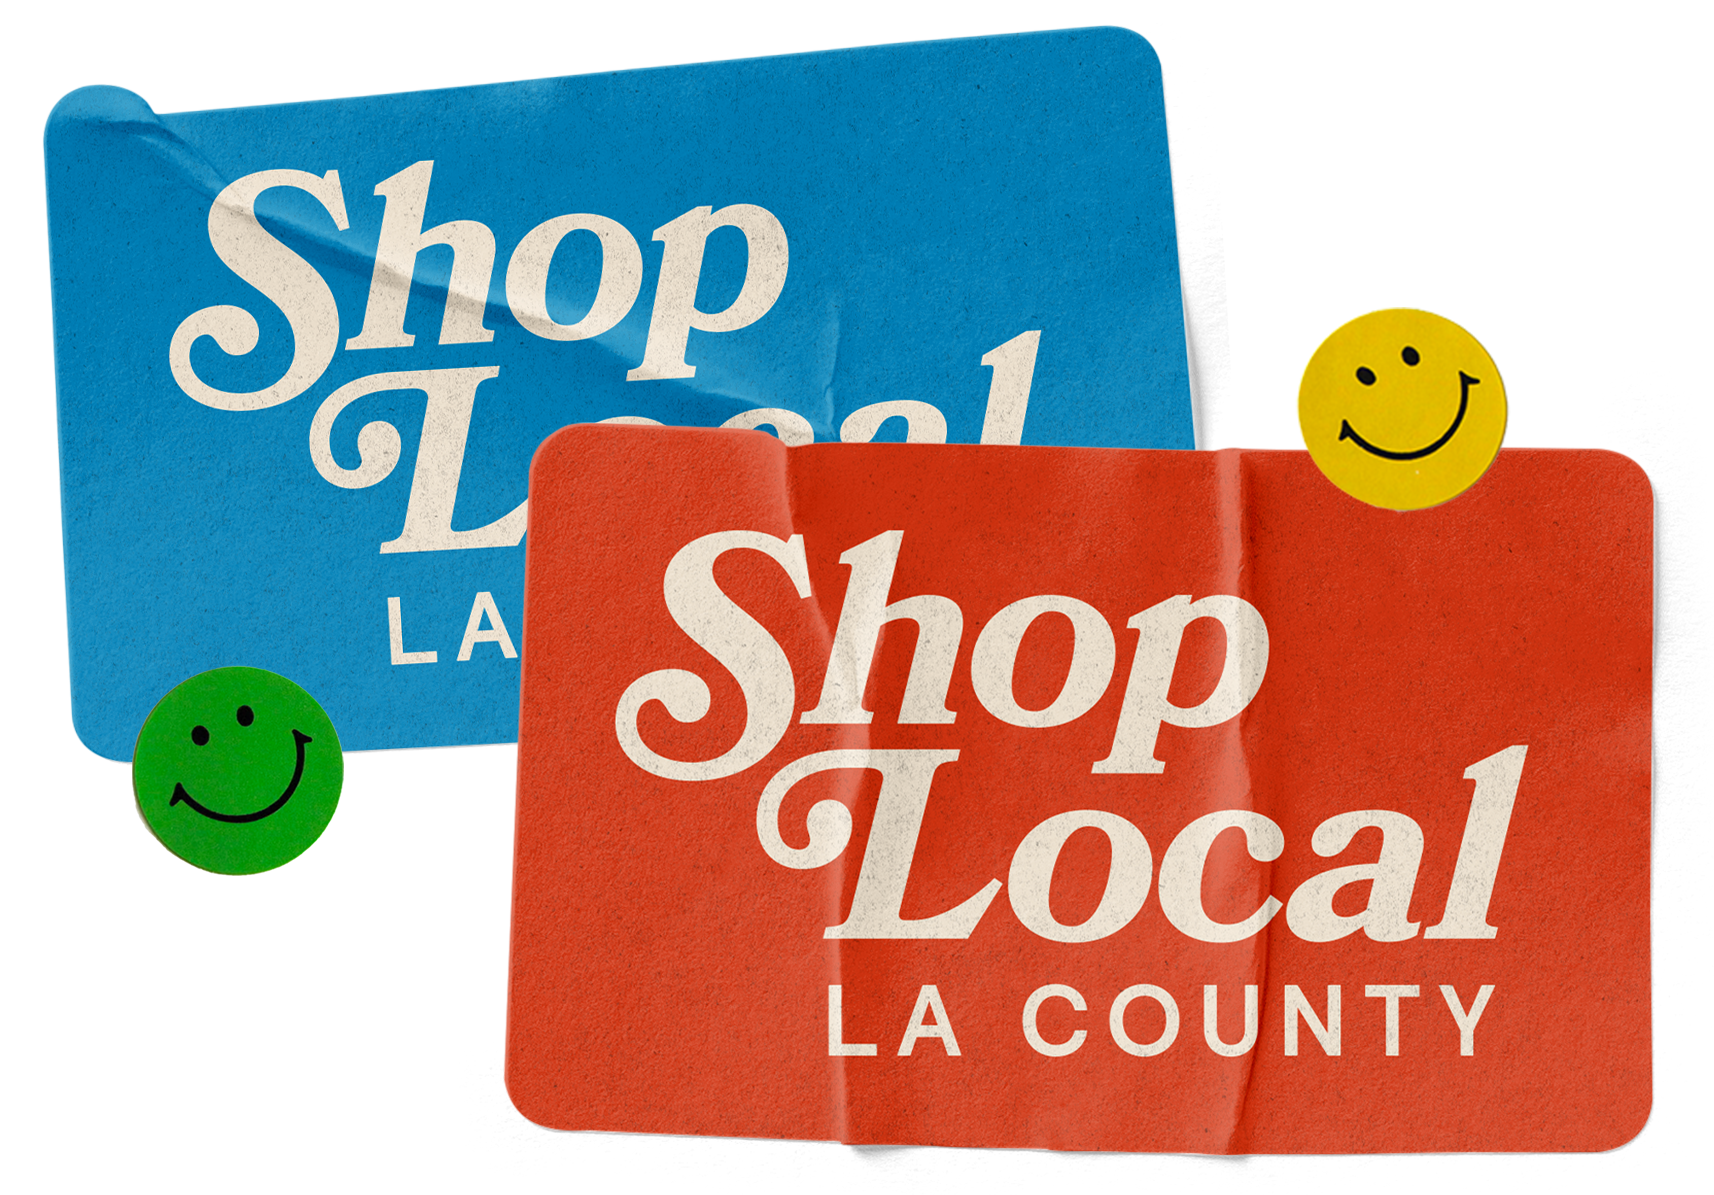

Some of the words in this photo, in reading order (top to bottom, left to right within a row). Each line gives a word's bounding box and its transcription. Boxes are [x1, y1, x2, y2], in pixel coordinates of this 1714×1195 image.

[168, 160, 789, 412] Shop
[387, 592, 519, 666] LA
[615, 530, 1269, 782] Shop
[756, 745, 1529, 943] Local
[827, 984, 962, 1057] LA
[1022, 983, 1496, 1057] COUNTY
